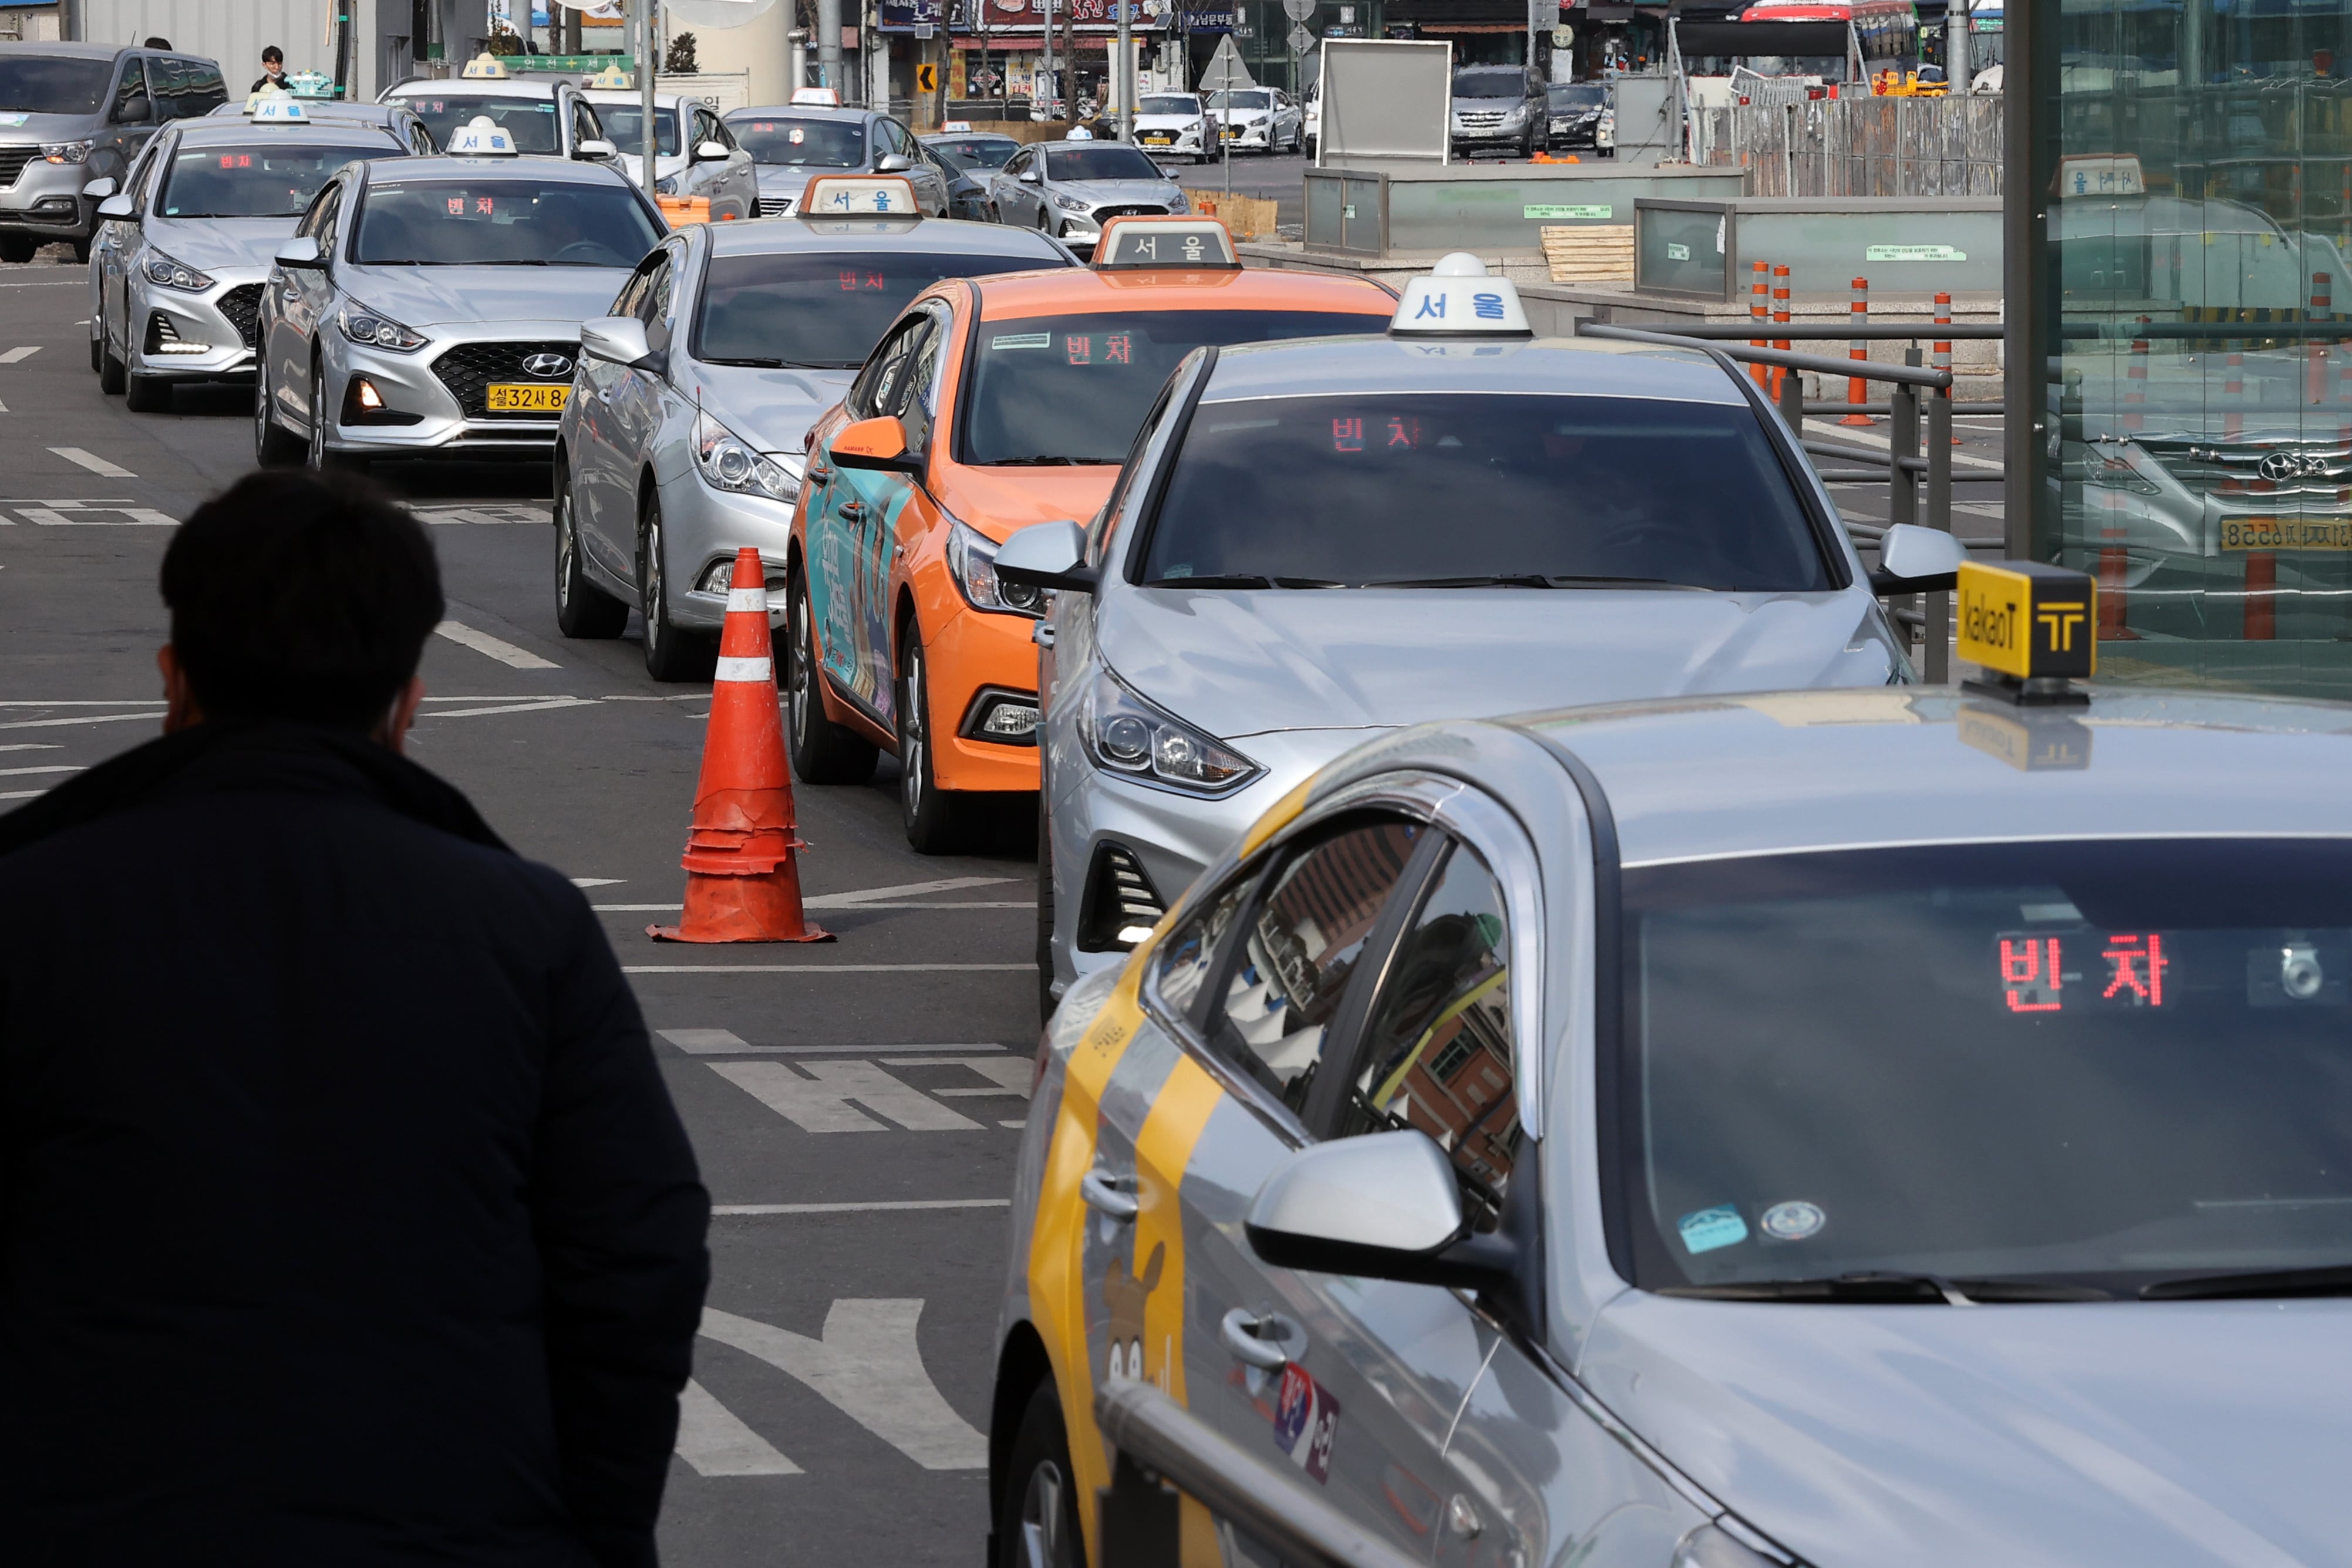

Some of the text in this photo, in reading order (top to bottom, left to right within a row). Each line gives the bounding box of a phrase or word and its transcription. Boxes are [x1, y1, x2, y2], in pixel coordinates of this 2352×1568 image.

[463, 136, 506, 149] 서울
[448, 197, 493, 215] 빈차
[834, 190, 891, 211] 서울
[1135, 235, 1205, 261] 서울
[1414, 292, 1505, 320] 서울
[1067, 333, 1130, 365] 빈차
[1999, 933, 2168, 1013] 빈차
